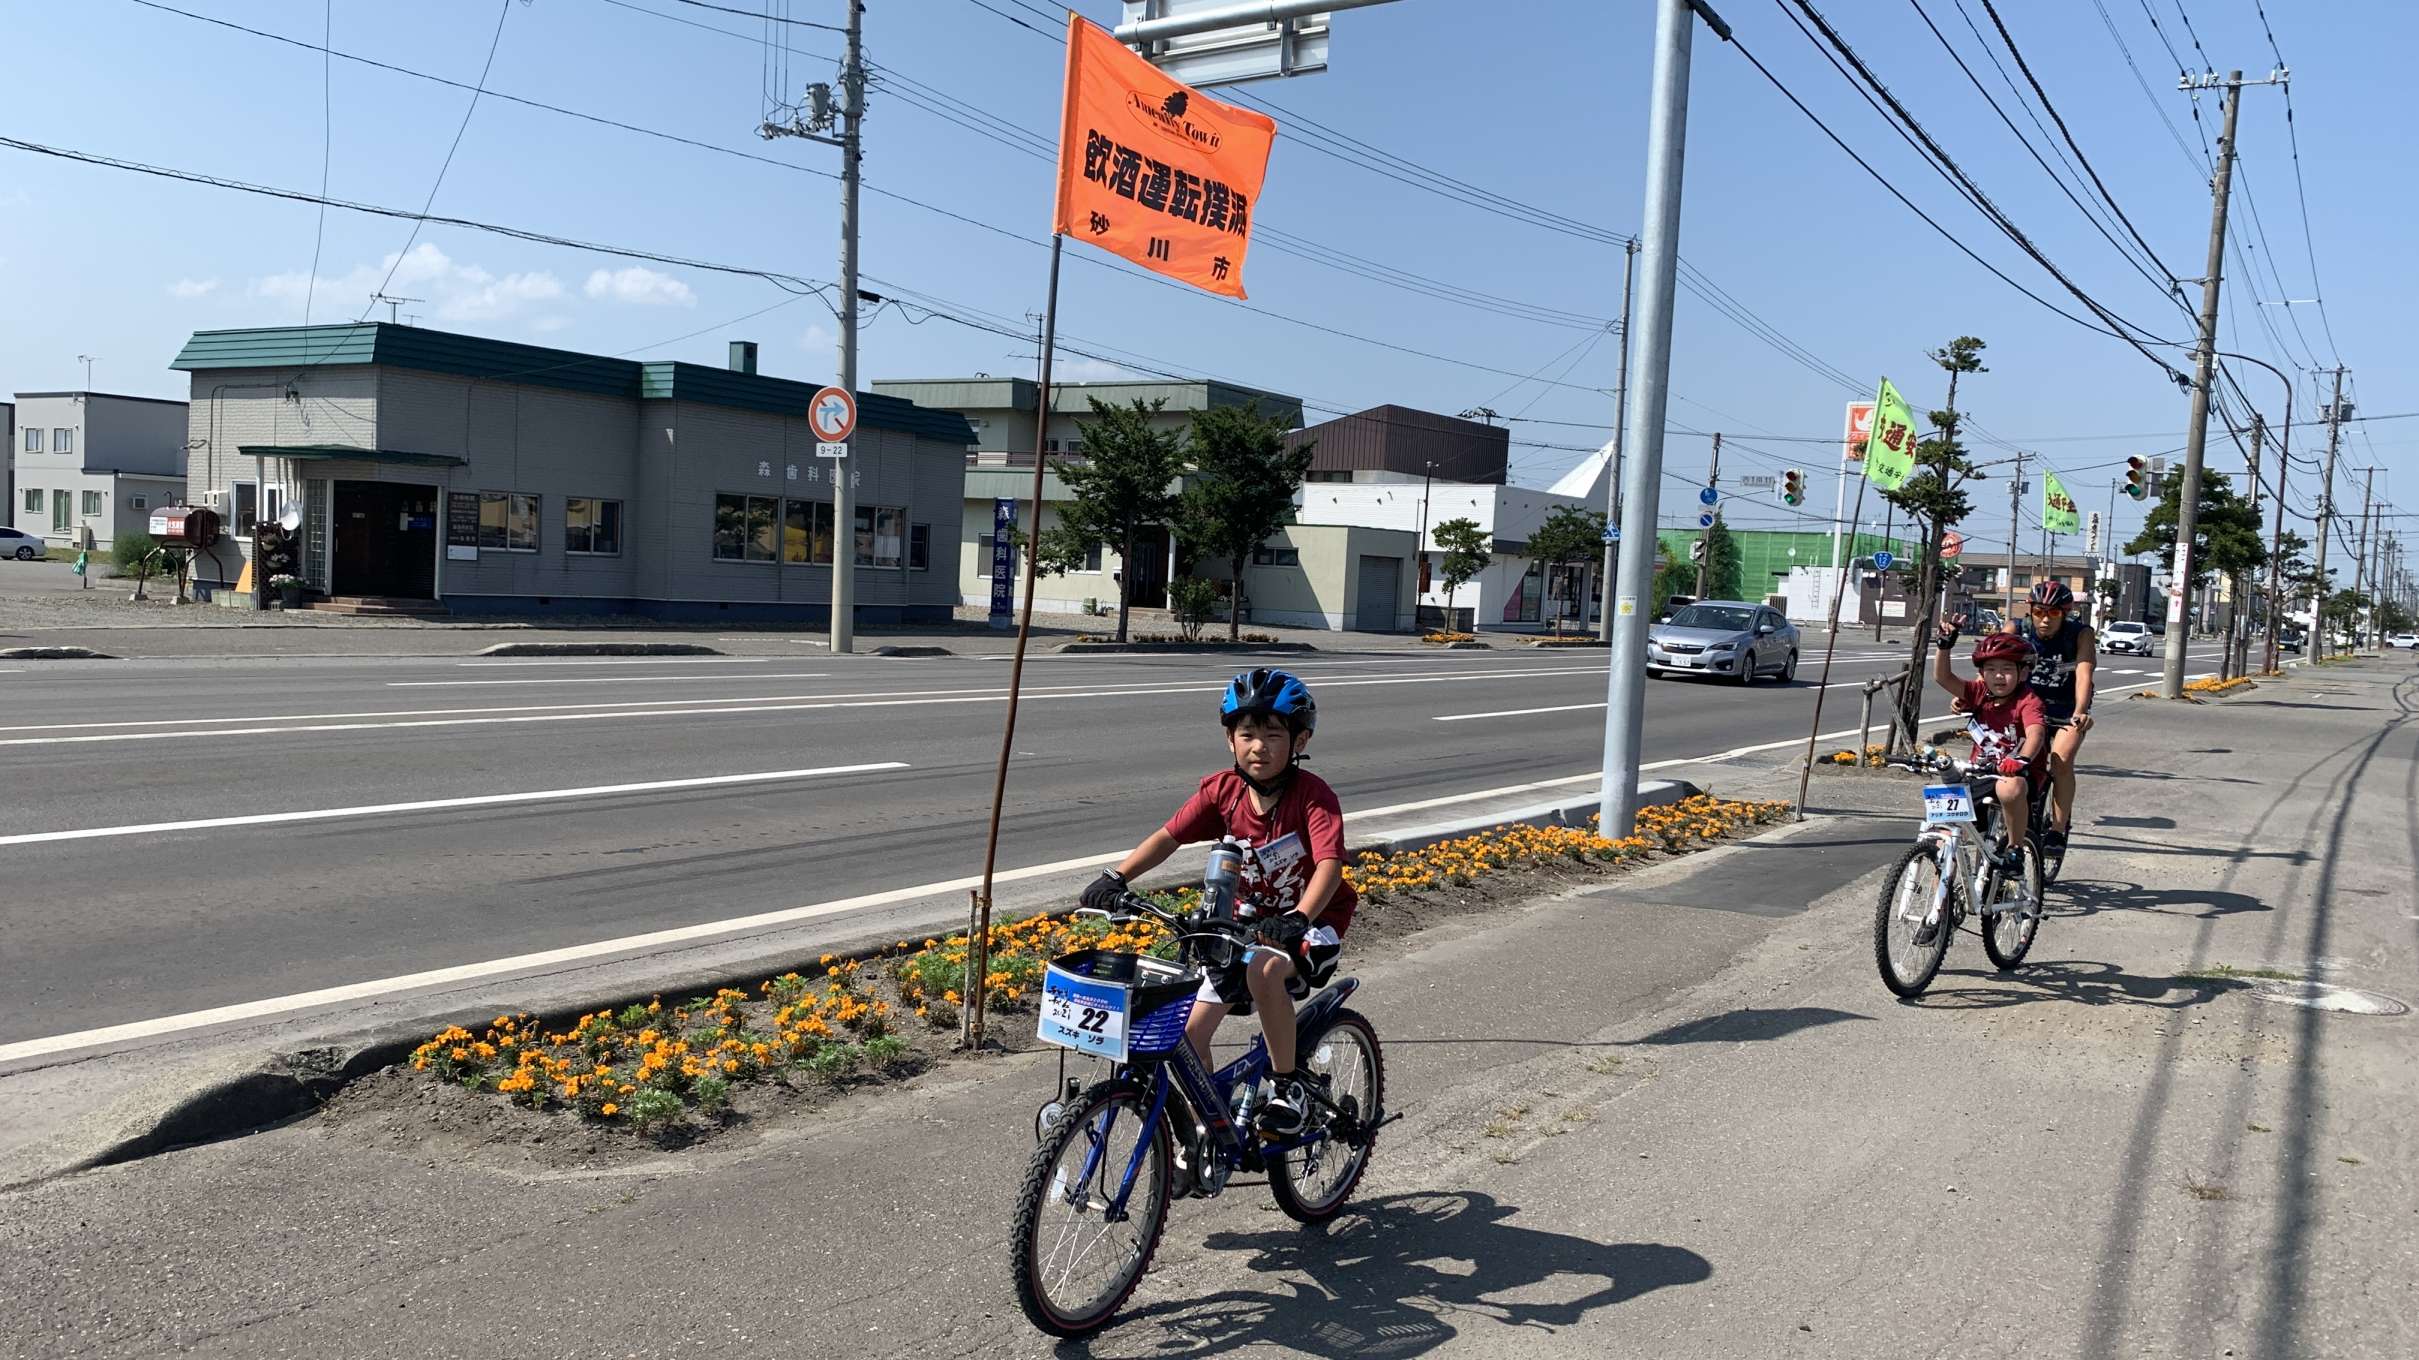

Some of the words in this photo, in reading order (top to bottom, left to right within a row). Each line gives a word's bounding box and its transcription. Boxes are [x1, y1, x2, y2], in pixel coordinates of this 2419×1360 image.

[1084, 128, 1248, 239] 飲酒運転撲滅
[1089, 210, 1231, 281] 砂川市
[820, 446, 843, 455] 9-22
[994, 505, 1010, 598] 森歯科医院
[1947, 799, 1960, 811] 27
[1058, 1025, 1079, 1040] スズキ
[1078, 1007, 1109, 1034] 22
